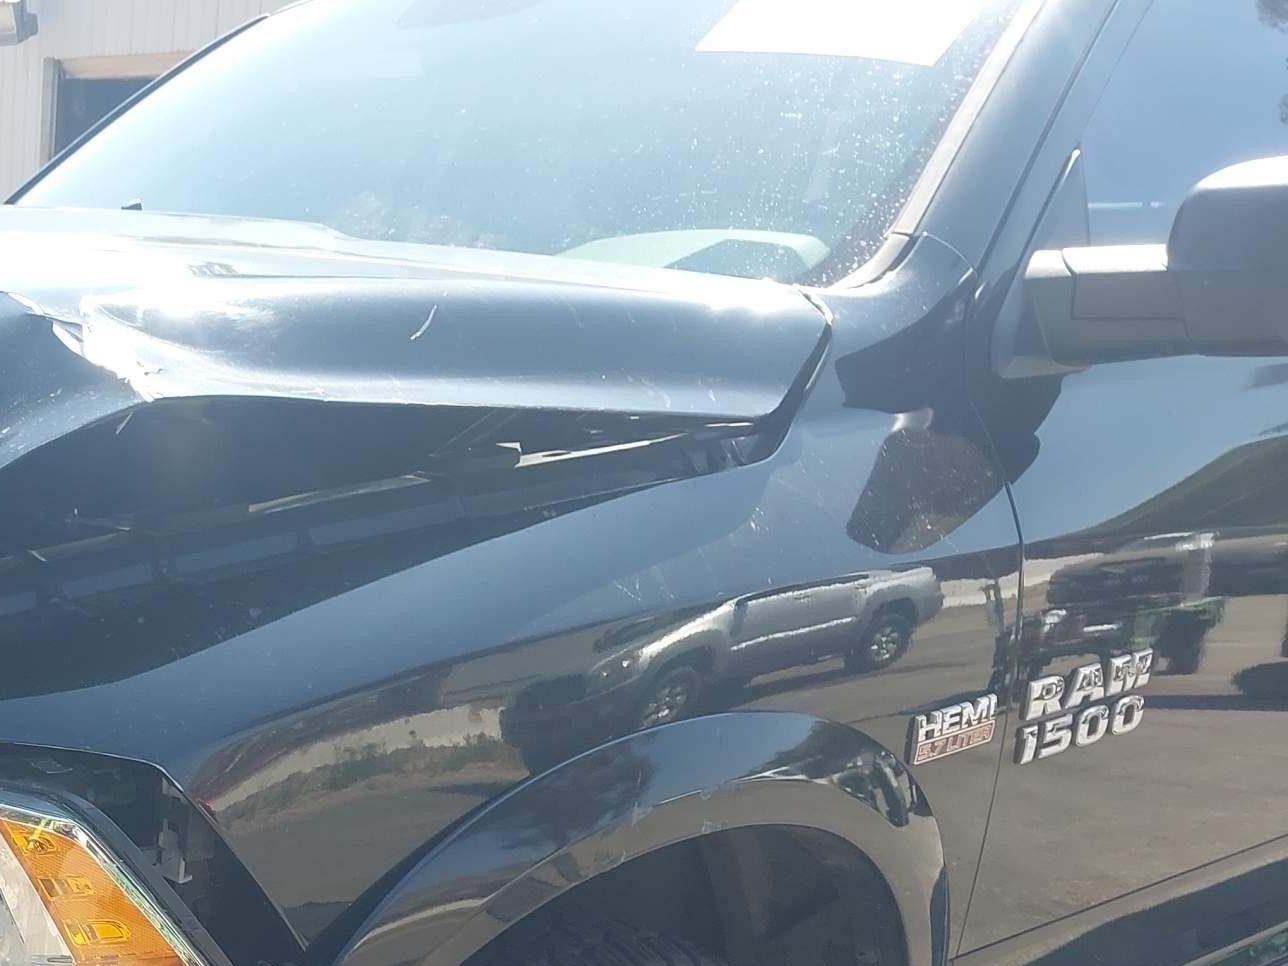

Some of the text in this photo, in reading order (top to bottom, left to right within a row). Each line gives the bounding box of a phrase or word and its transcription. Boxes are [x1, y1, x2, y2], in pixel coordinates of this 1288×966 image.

[1025, 648, 1154, 721] RAM
[916, 693, 998, 741] HEMI
[946, 725, 993, 752] LITER
[1019, 695, 1145, 765] 1500
